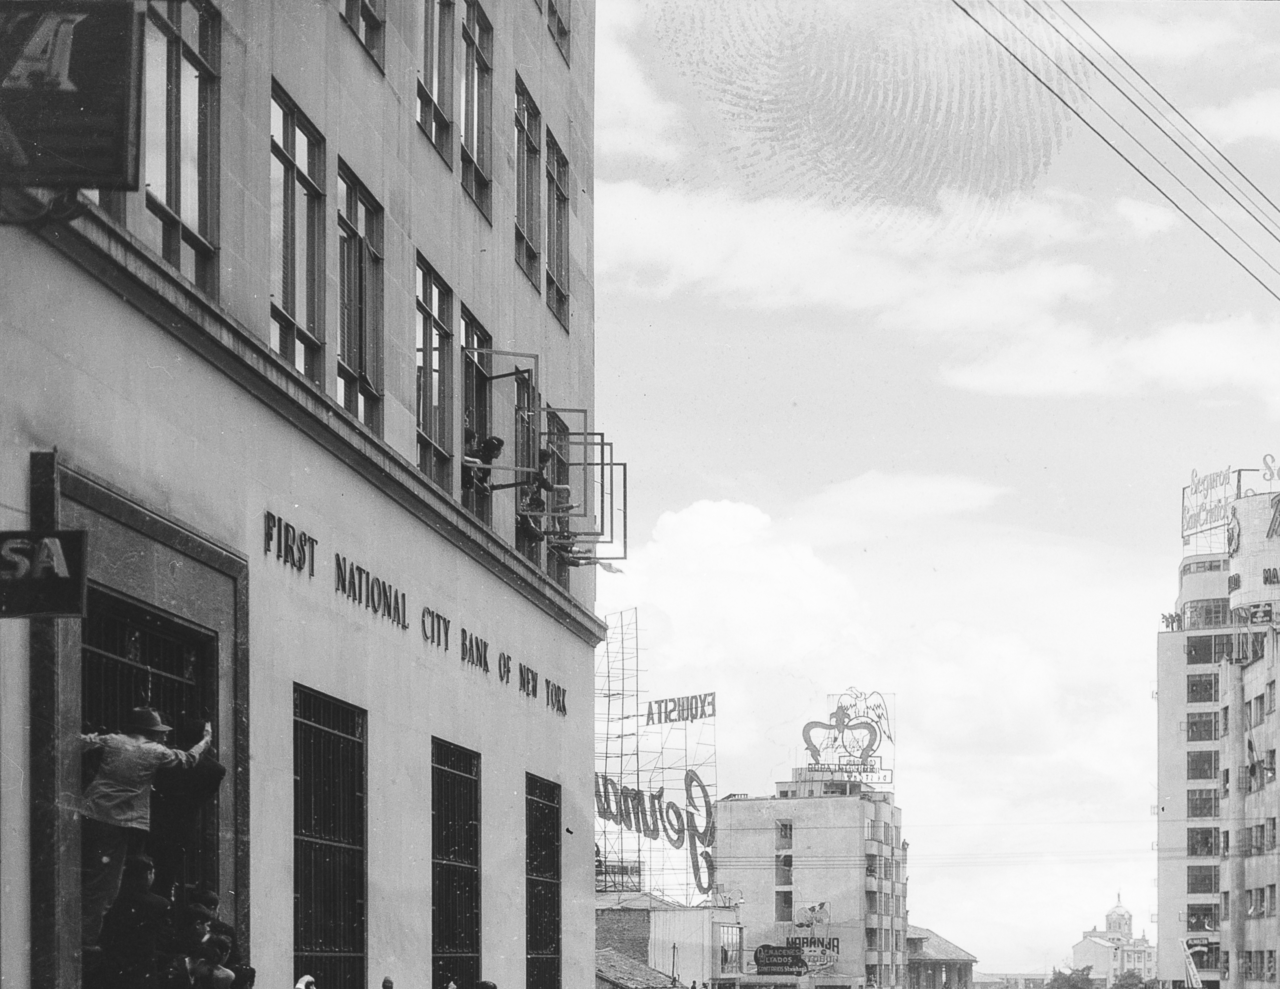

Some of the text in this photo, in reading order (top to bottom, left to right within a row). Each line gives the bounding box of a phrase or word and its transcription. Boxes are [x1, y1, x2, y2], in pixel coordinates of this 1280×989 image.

[1191, 465, 1231, 499] Seguros
[264, 510, 567, 717] FIRST NATIONAL CITY BANK OF NEW YORK
